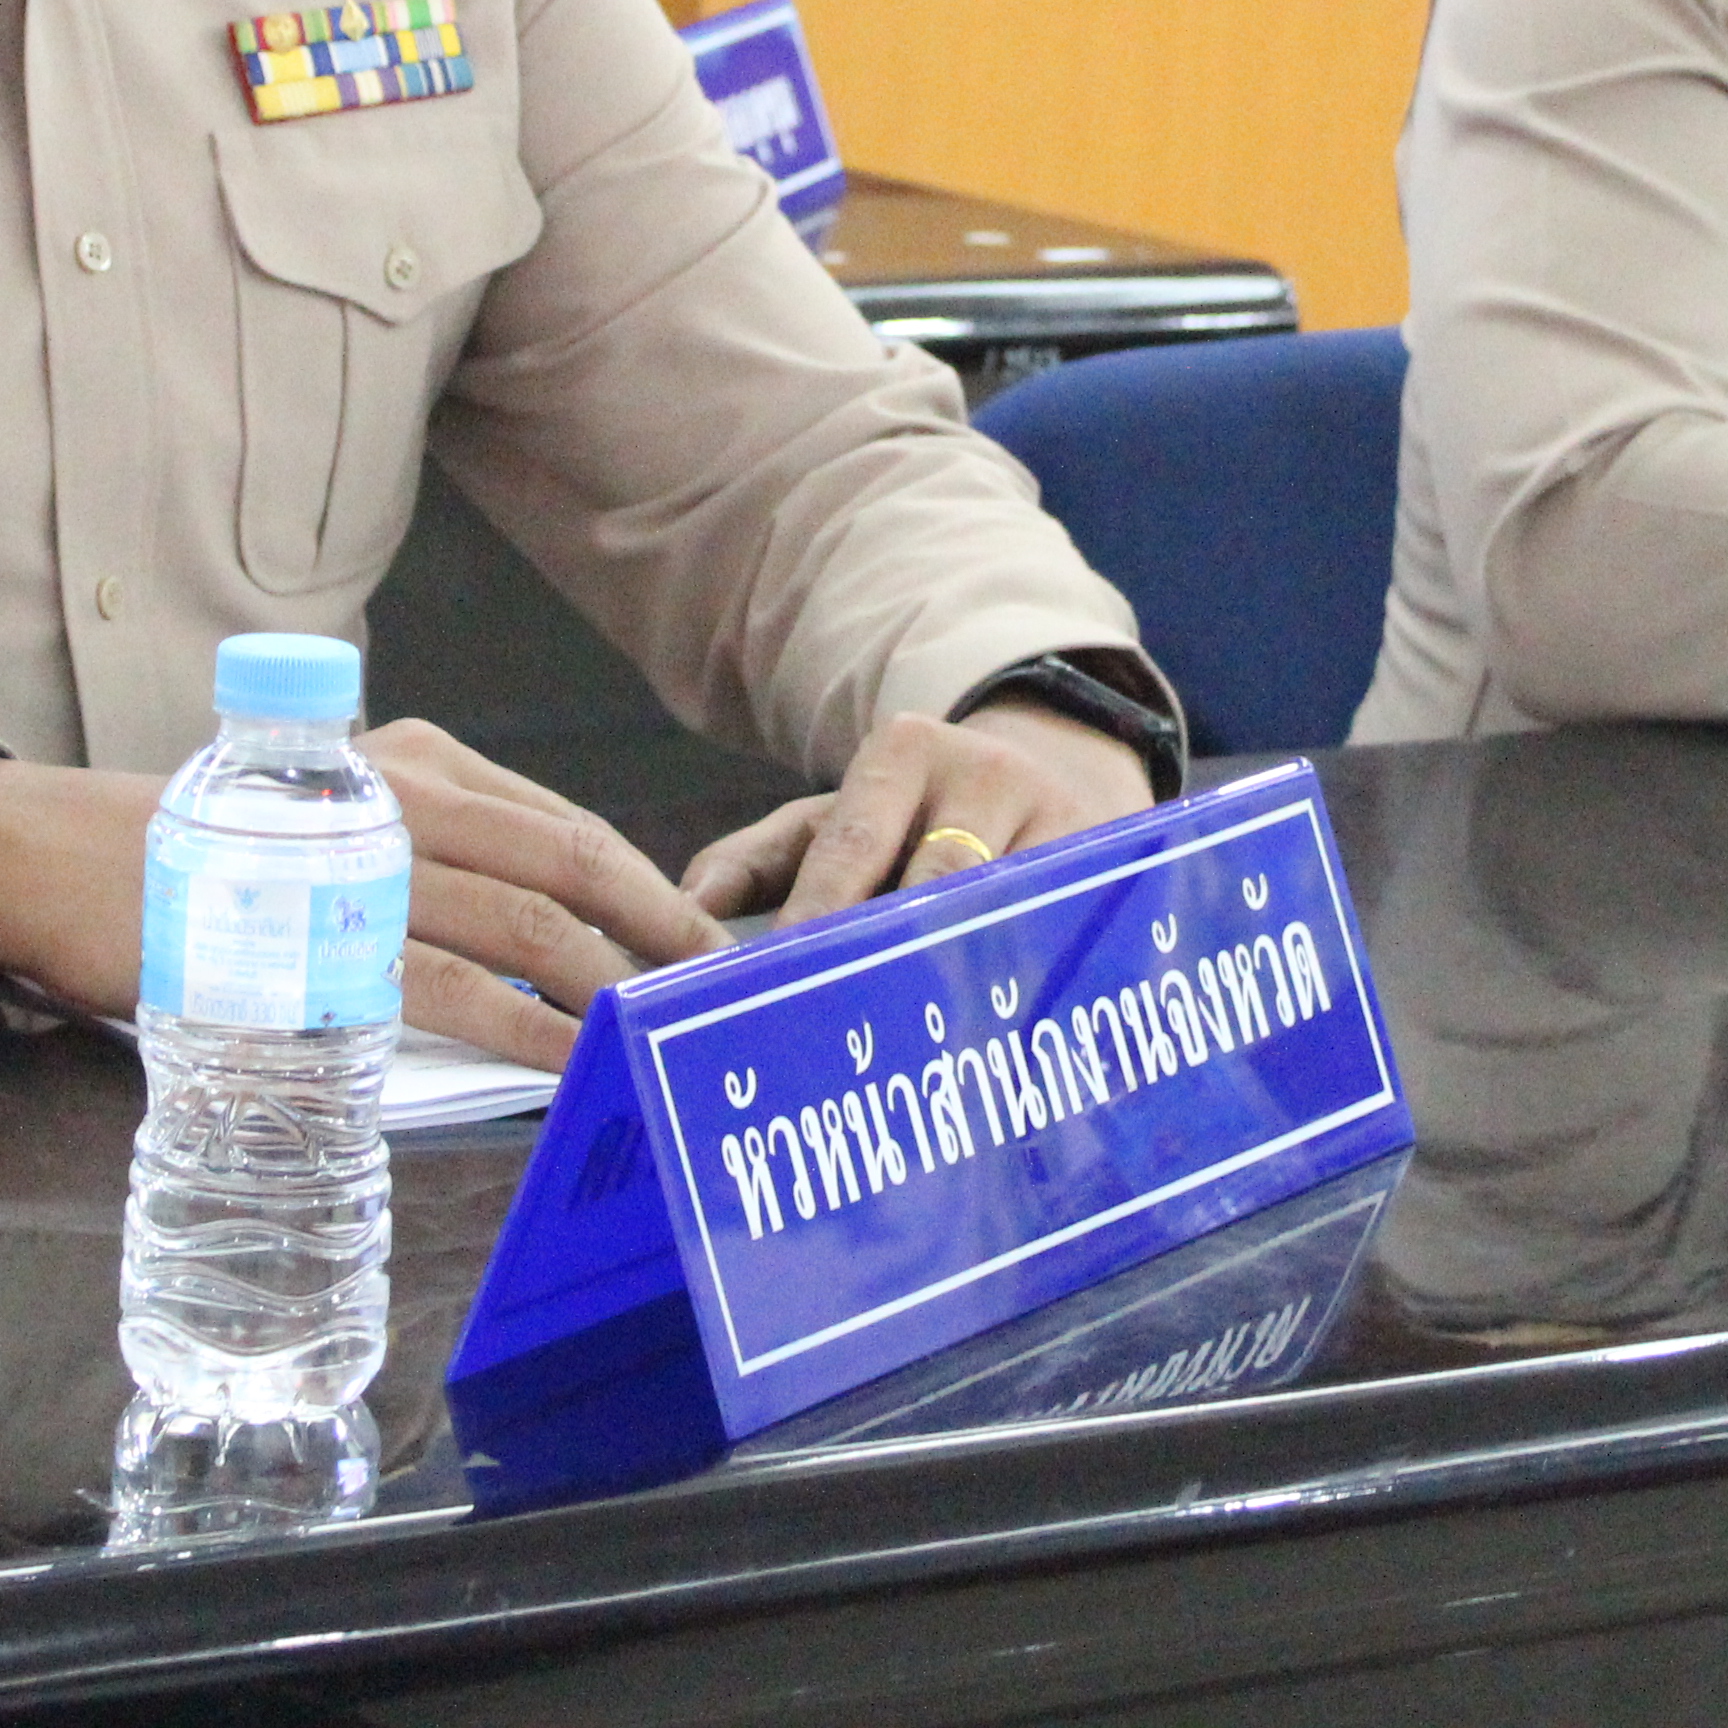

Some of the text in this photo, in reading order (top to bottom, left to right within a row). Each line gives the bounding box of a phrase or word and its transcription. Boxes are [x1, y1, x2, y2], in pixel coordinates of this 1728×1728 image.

[719, 873, 1333, 1241] หัวหน้าสำนักงานจังหวัด
